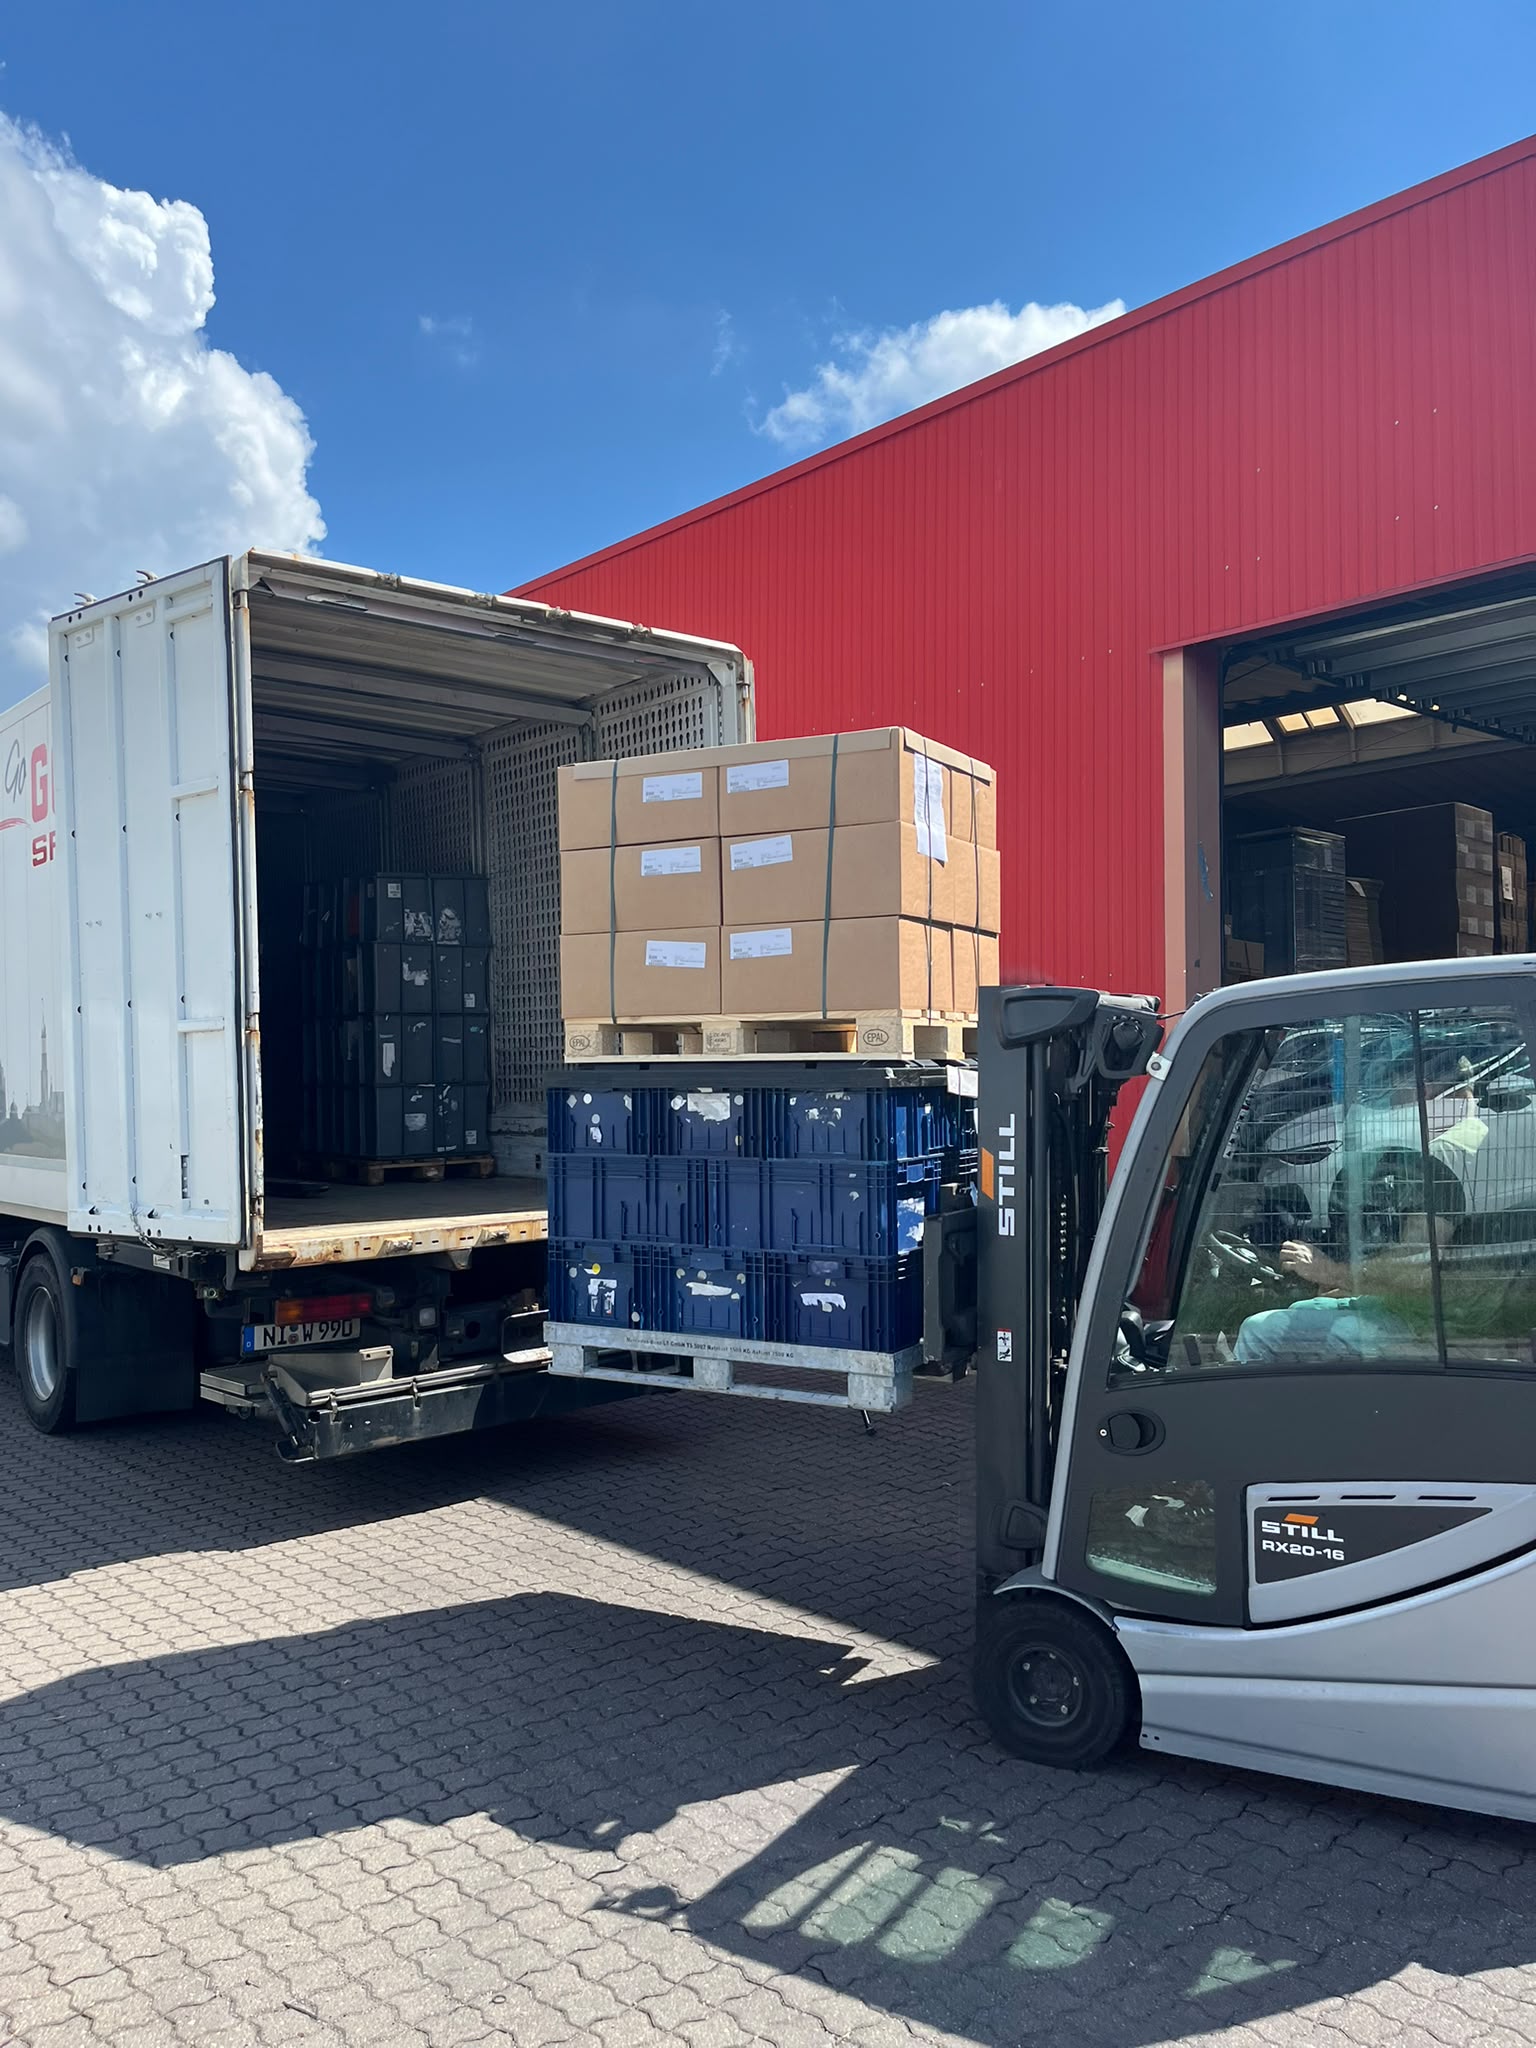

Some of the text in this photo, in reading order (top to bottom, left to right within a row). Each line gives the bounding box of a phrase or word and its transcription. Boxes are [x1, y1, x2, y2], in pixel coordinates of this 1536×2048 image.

[5, 739, 56, 823] Go G
[867, 1032, 885, 1043] EPAL
[998, 1113, 1015, 1237] STILL
[263, 1326, 287, 1347] NI
[302, 1322, 314, 1342] W
[1261, 1520, 1344, 1543] STILL
[1262, 1539, 1345, 1561] RX20-16
